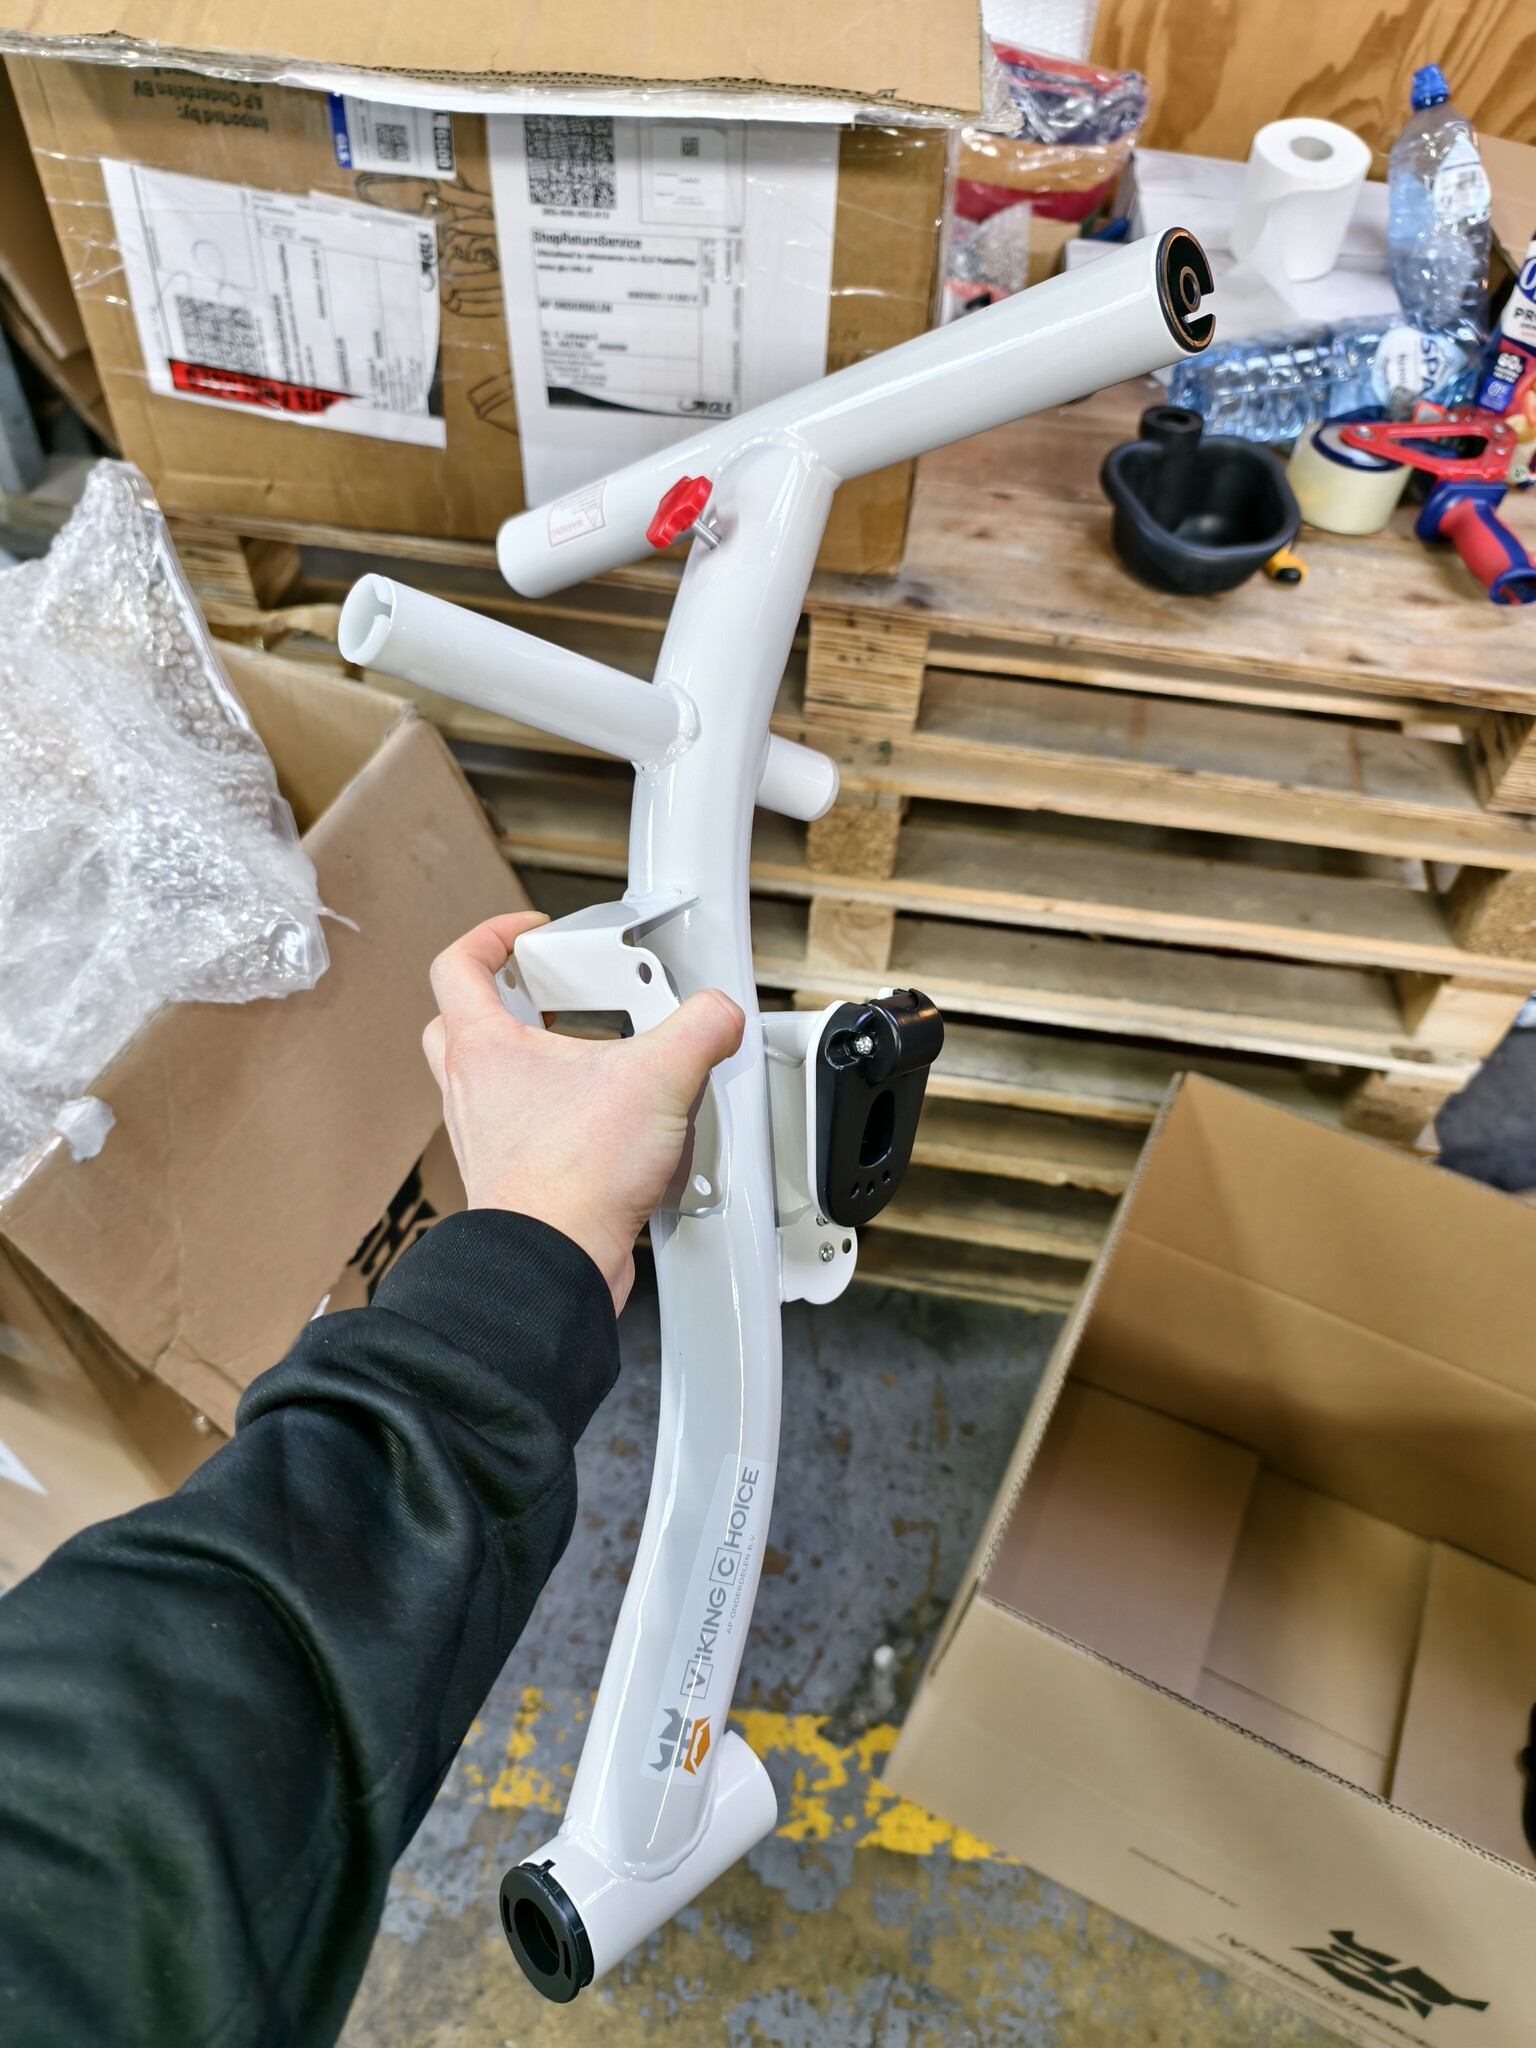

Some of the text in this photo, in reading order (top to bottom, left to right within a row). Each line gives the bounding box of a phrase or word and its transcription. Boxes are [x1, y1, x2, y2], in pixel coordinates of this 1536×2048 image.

[203, 110, 269, 132] Imported
[1421, 338, 1438, 395] SPA
[683, 1466, 760, 1693] VIKING CHOICE
[725, 1532, 757, 1635] AP ONDERDELEN B.V.
